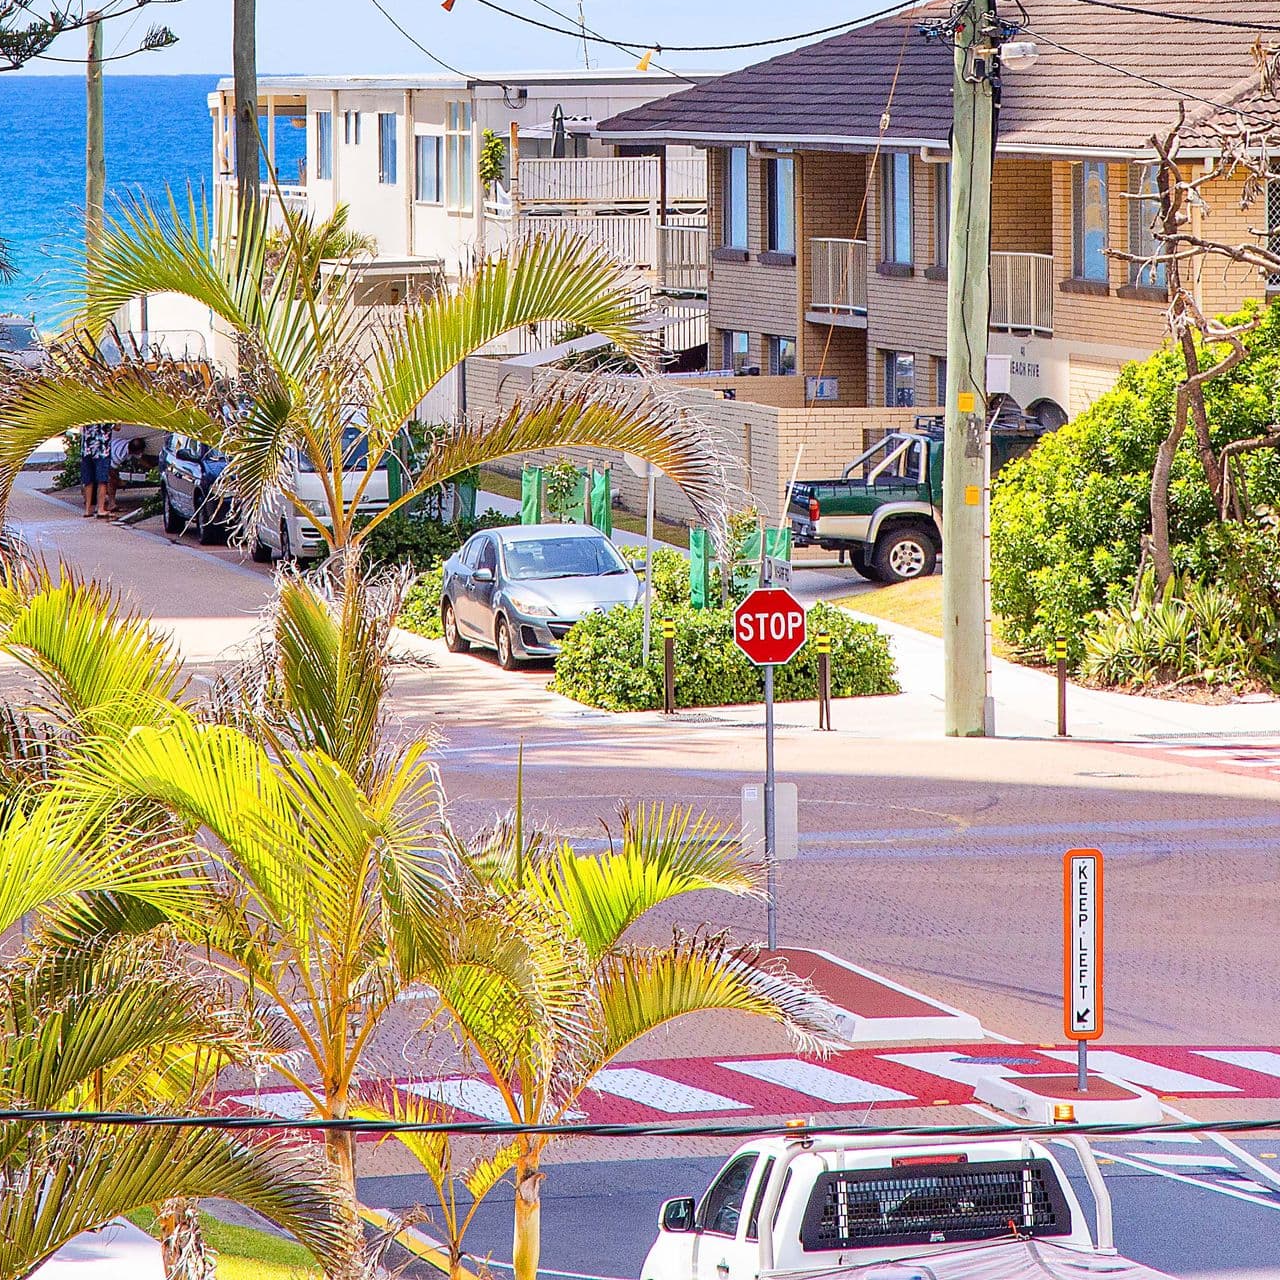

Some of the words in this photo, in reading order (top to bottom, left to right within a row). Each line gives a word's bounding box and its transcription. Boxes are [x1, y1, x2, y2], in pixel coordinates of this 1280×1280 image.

[739, 612, 803, 642] STOP
[1078, 865, 1088, 928] KEEP
[1079, 937, 1088, 1000] LEFT
